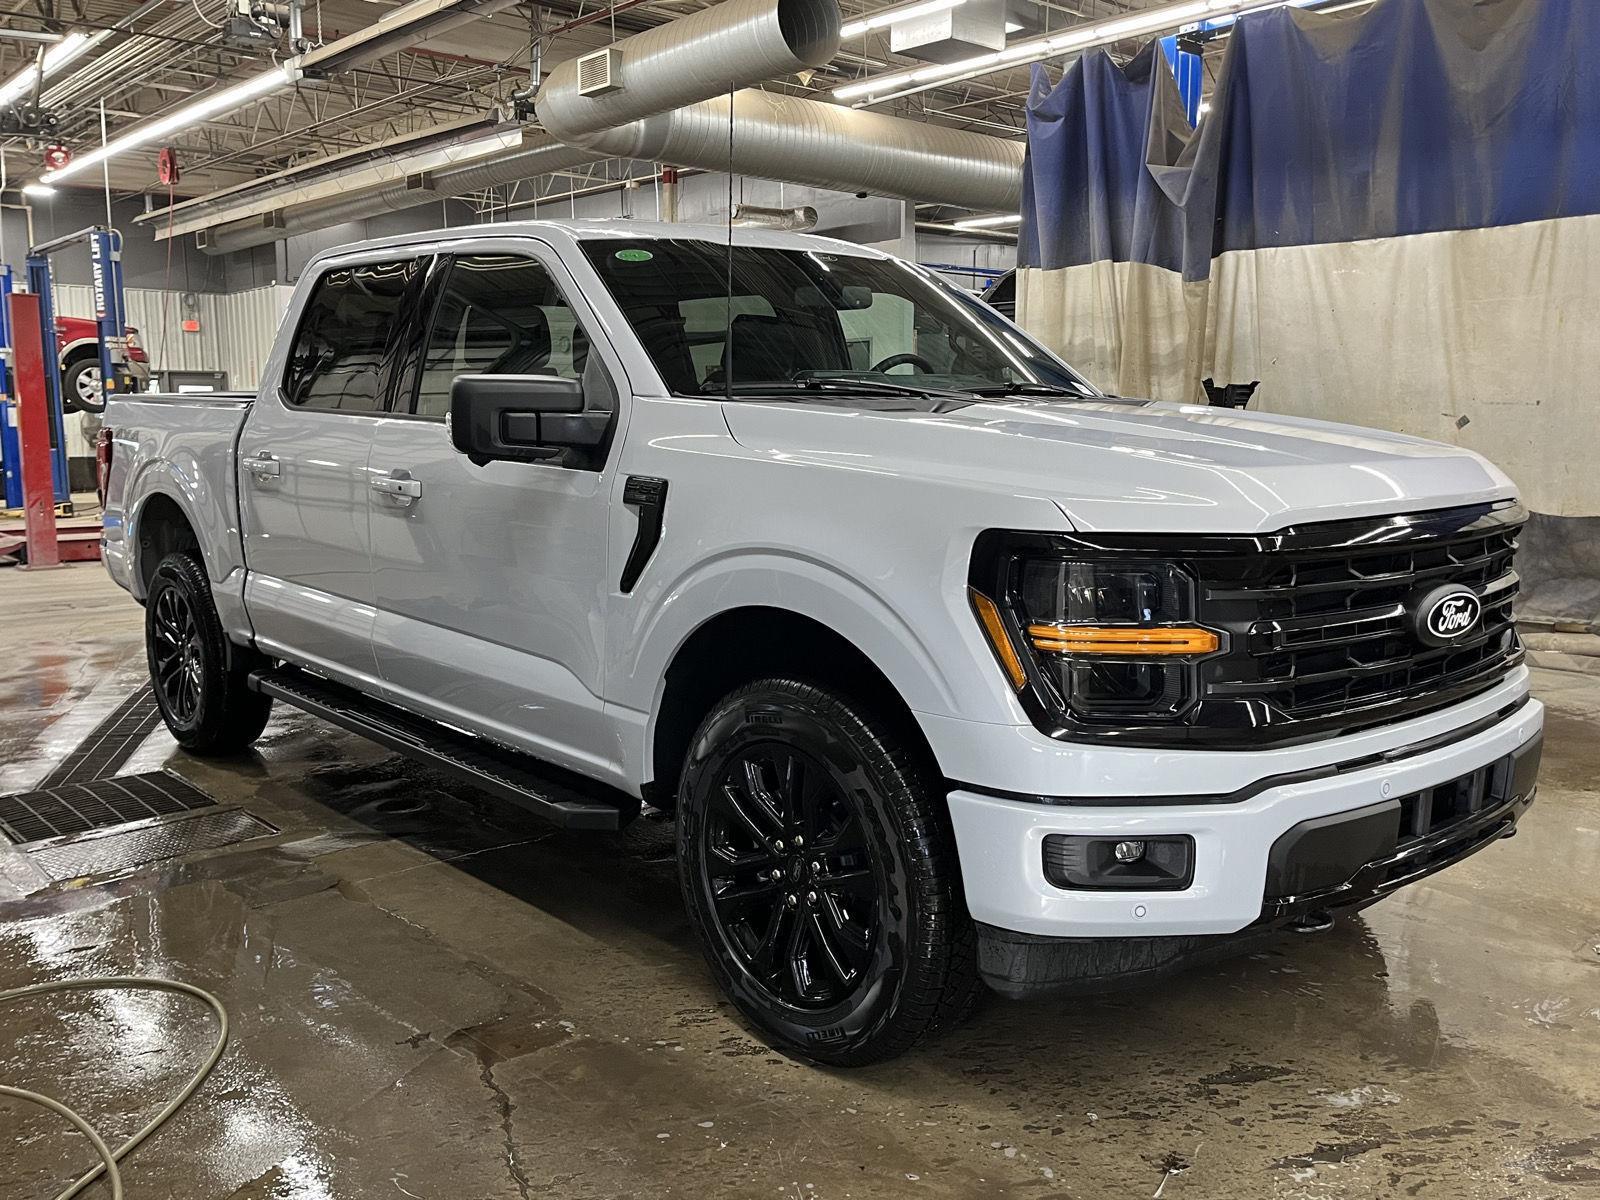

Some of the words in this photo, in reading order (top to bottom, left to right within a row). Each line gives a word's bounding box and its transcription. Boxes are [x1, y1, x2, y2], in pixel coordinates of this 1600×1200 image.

[90, 233, 101, 260] LIFT
[92, 262, 105, 311] ROTARY
[1438, 599, 1472, 632] Ford
